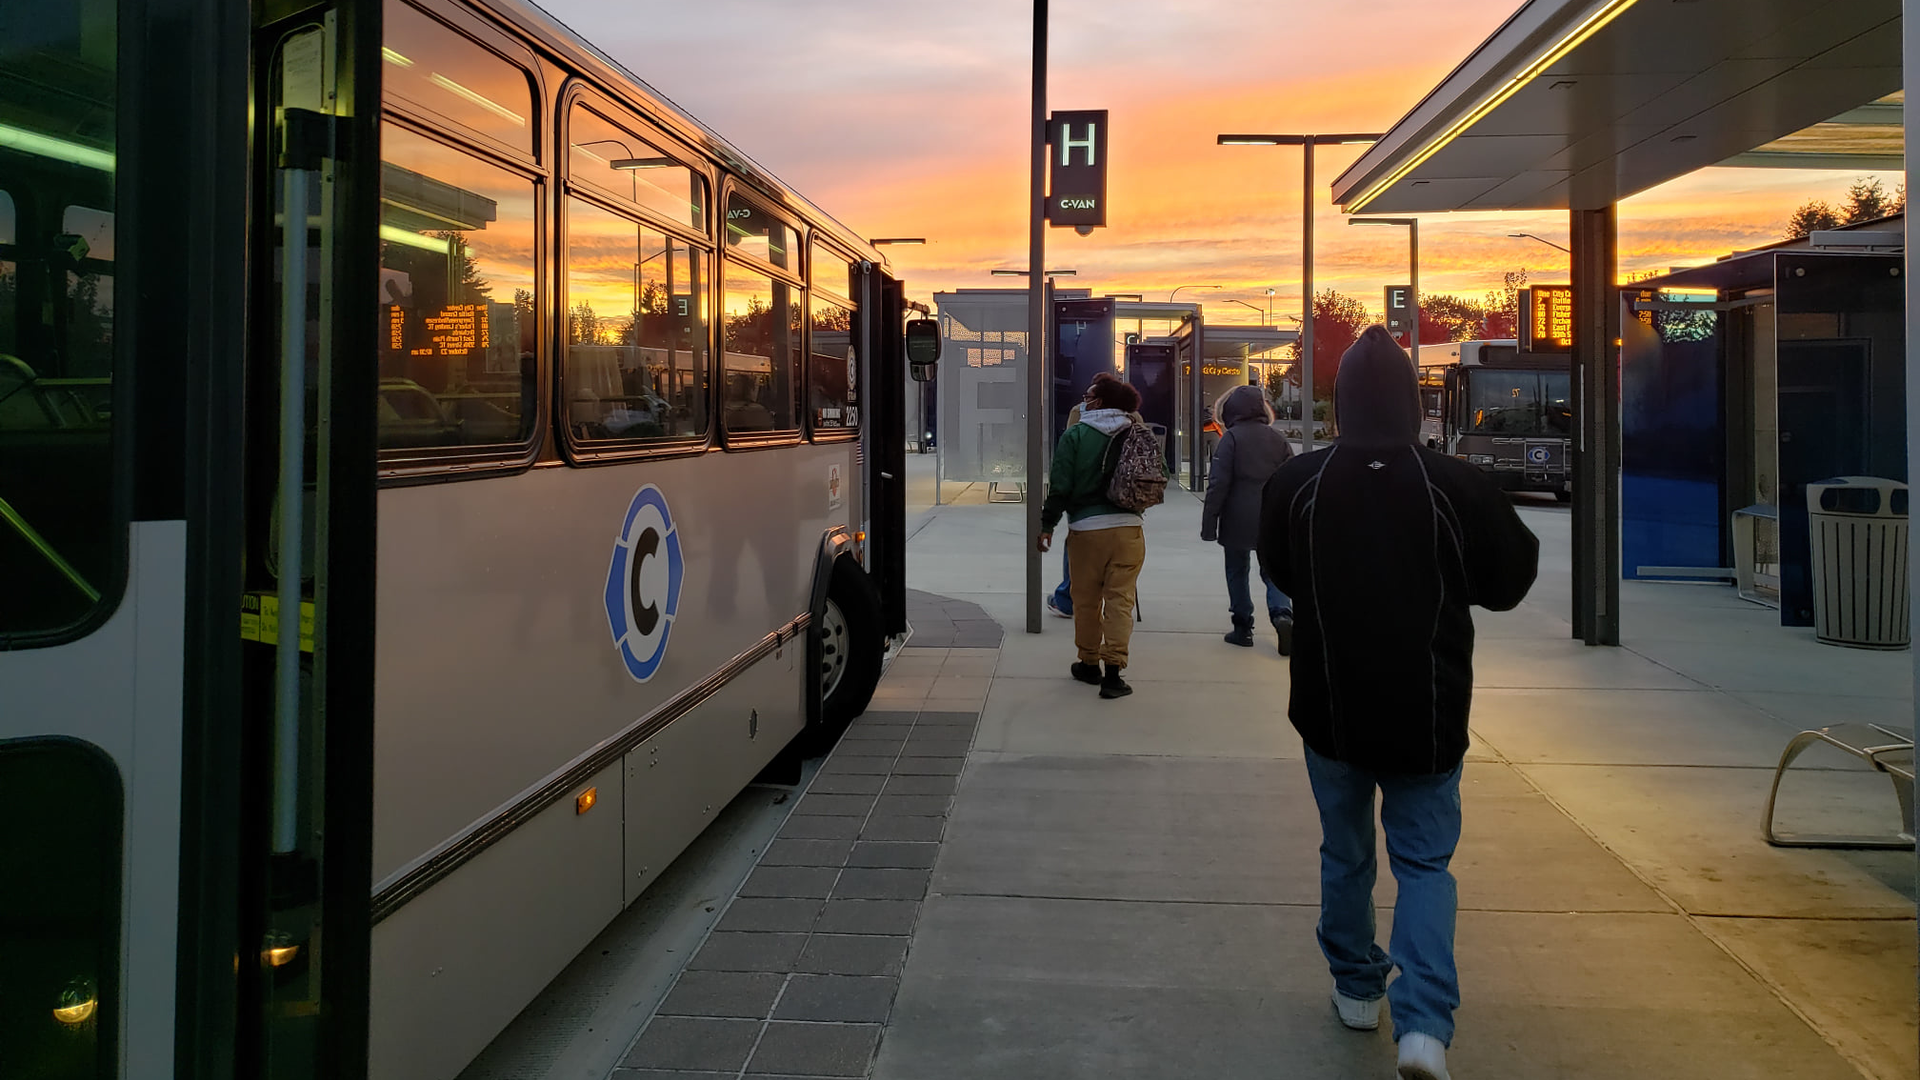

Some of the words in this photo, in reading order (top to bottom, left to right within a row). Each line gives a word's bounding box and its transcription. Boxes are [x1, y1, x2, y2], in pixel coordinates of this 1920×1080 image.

[1063, 124, 1095, 166] H
[1061, 200, 1095, 209] C-VAN
[1393, 290, 1405, 308] E
[631, 527, 660, 636] C
